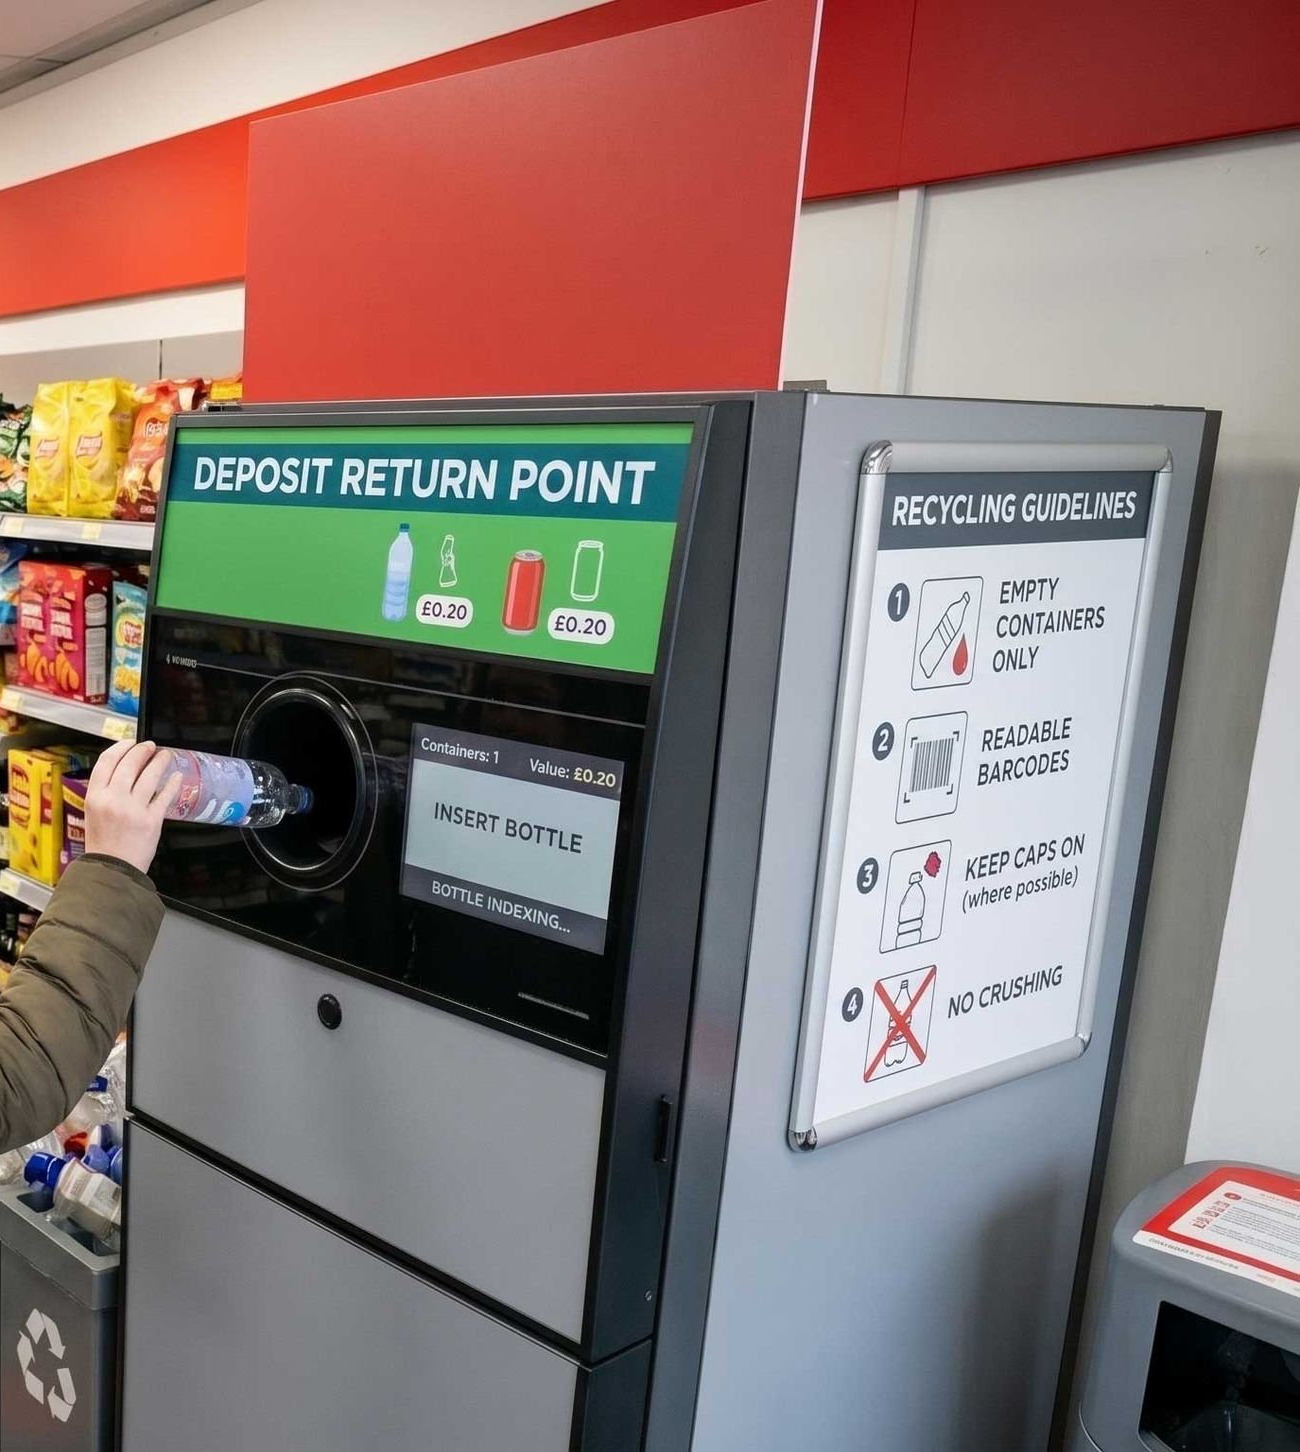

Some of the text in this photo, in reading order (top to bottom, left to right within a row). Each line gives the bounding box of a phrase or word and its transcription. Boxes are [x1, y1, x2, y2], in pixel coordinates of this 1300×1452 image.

[194, 456, 656, 505] DEPOSIT RETURN POINT
[892, 491, 1137, 526] RECYCLING GUIDELINES
[895, 588, 904, 616] 1
[1000, 577, 1059, 605] EMPTY
[421, 600, 467, 623] £0.20
[554, 615, 607, 638] £0.20
[996, 606, 1105, 639] CONTAINERS
[992, 645, 1039, 674] ONLY
[877, 729, 888, 752] 2
[981, 717, 1072, 752] READABLE
[421, 737, 616, 788] Containers: 1 Value: £0.20
[977, 749, 1070, 787] BARCODES
[434, 801, 583, 854] INSERT BOTTLE
[965, 833, 1086, 881] KEEP CAPS ON
[862, 864, 874, 890] 3
[962, 865, 1079, 914] (where possible)
[432, 880, 571, 935] BOTTLE INDEXING...
[846, 993, 858, 1017] 4
[948, 964, 1063, 1019] NO CRUSHING
